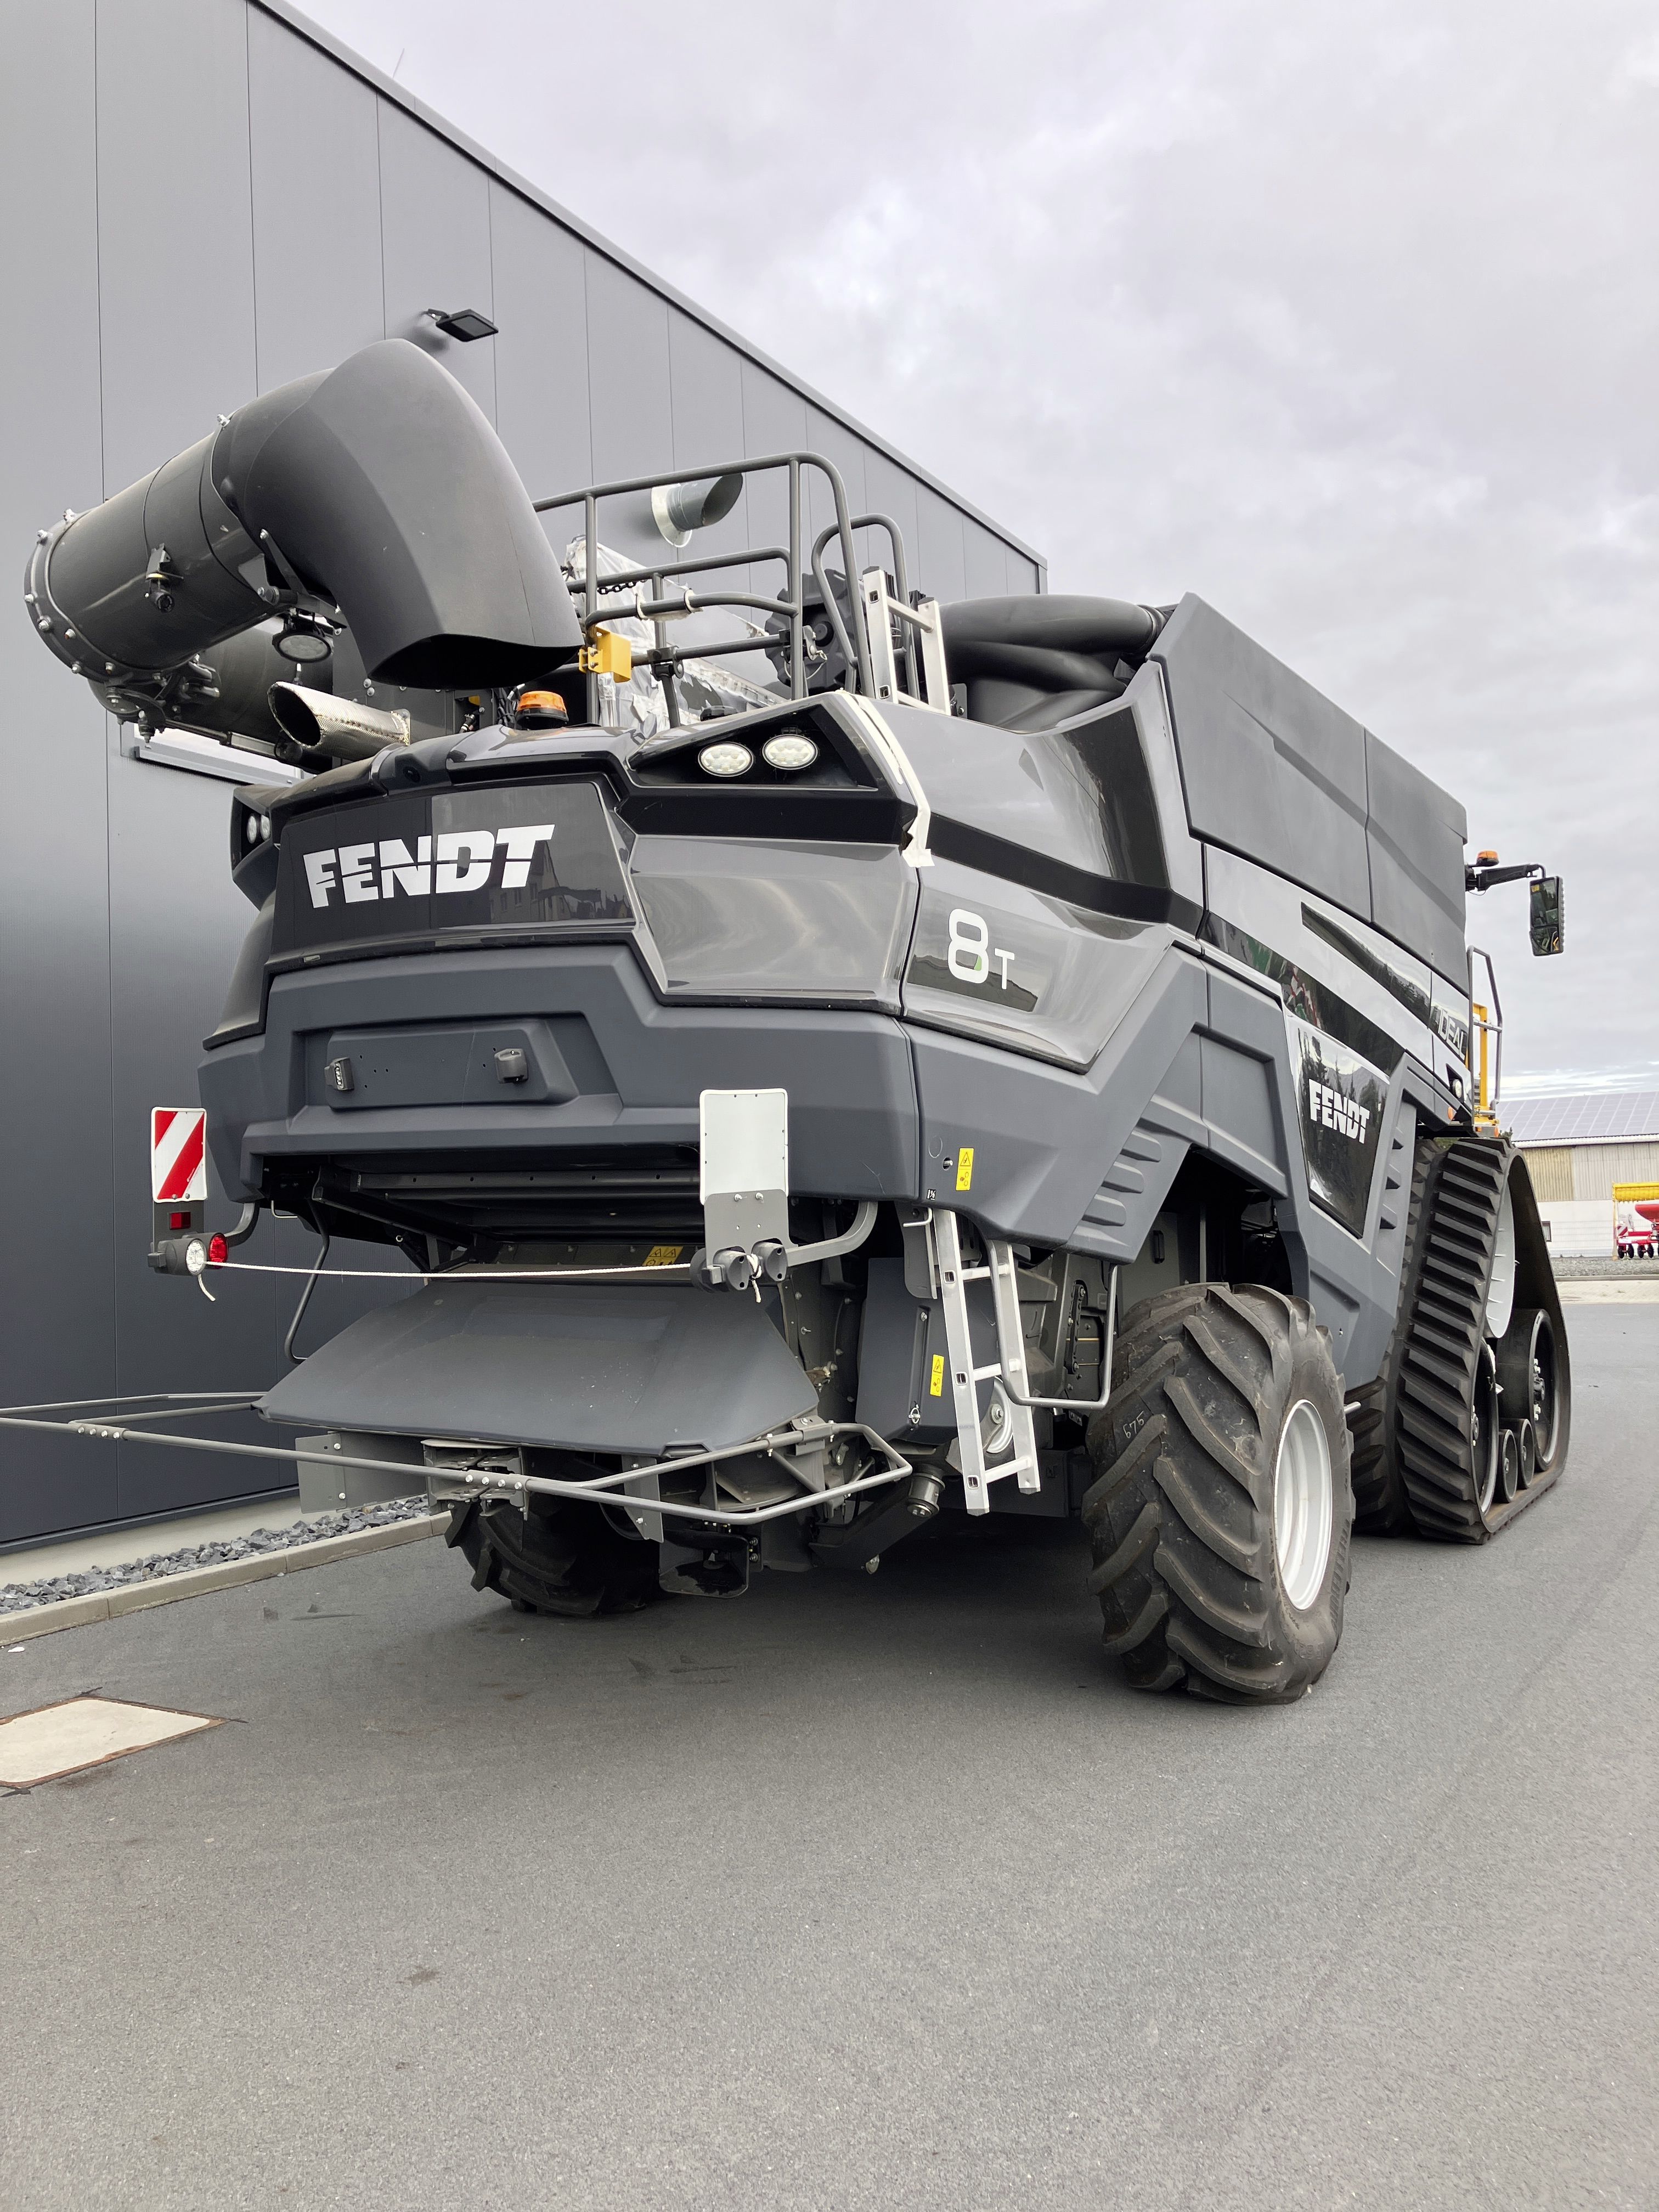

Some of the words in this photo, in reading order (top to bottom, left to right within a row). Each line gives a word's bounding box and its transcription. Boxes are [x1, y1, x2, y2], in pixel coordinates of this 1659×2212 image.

[303, 824, 555, 909] FENDT
[1438, 1007, 1466, 1061] IDEAL
[1309, 1079, 1370, 1144] FENDT
[1123, 1410, 1144, 1439] 675
